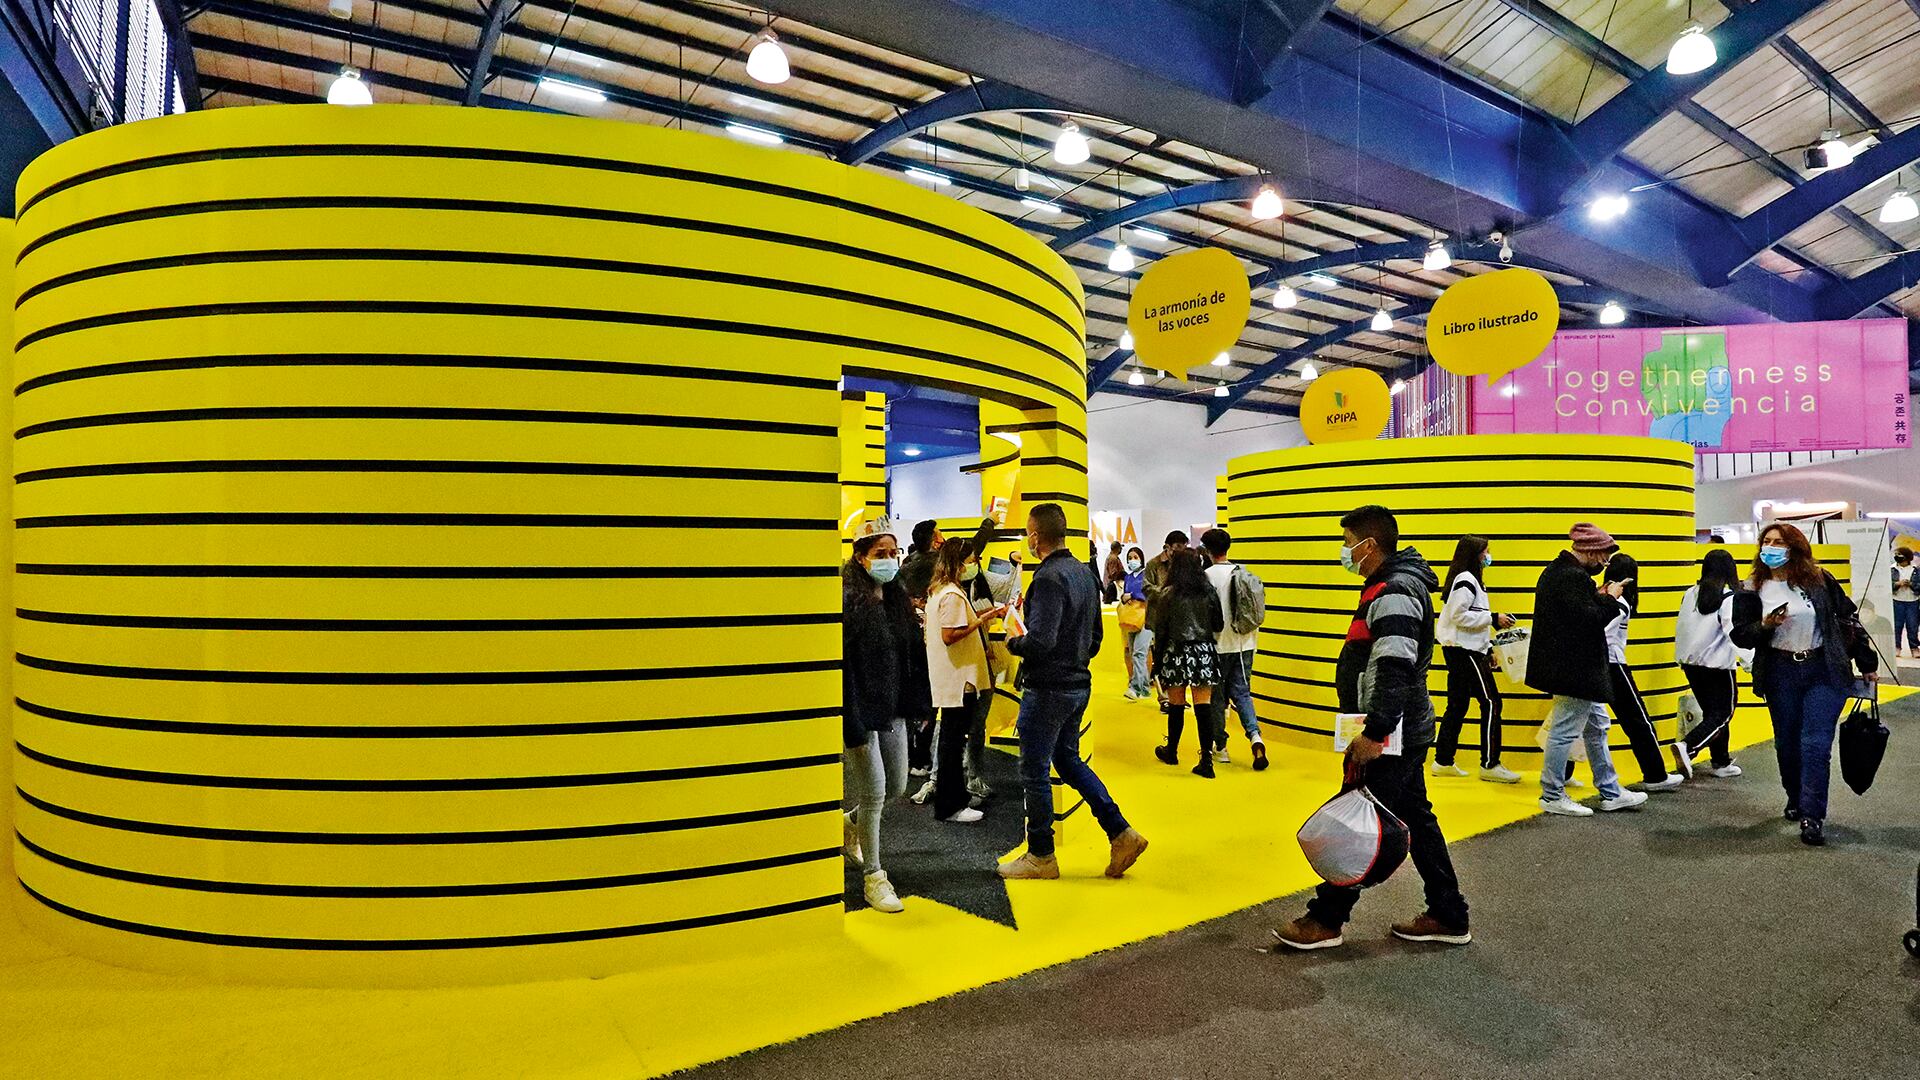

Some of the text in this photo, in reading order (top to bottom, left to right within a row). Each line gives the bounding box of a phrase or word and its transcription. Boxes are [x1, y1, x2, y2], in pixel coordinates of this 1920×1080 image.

[1144, 290, 1226, 319] La armonía de
[1158, 313, 1210, 332] las voces
[1443, 309, 1538, 336] Libro ilustrado
[1542, 364, 1832, 393] Togetherness
[1555, 389, 1815, 417] Convivencia
[1326, 411, 1358, 425] KPIPA
